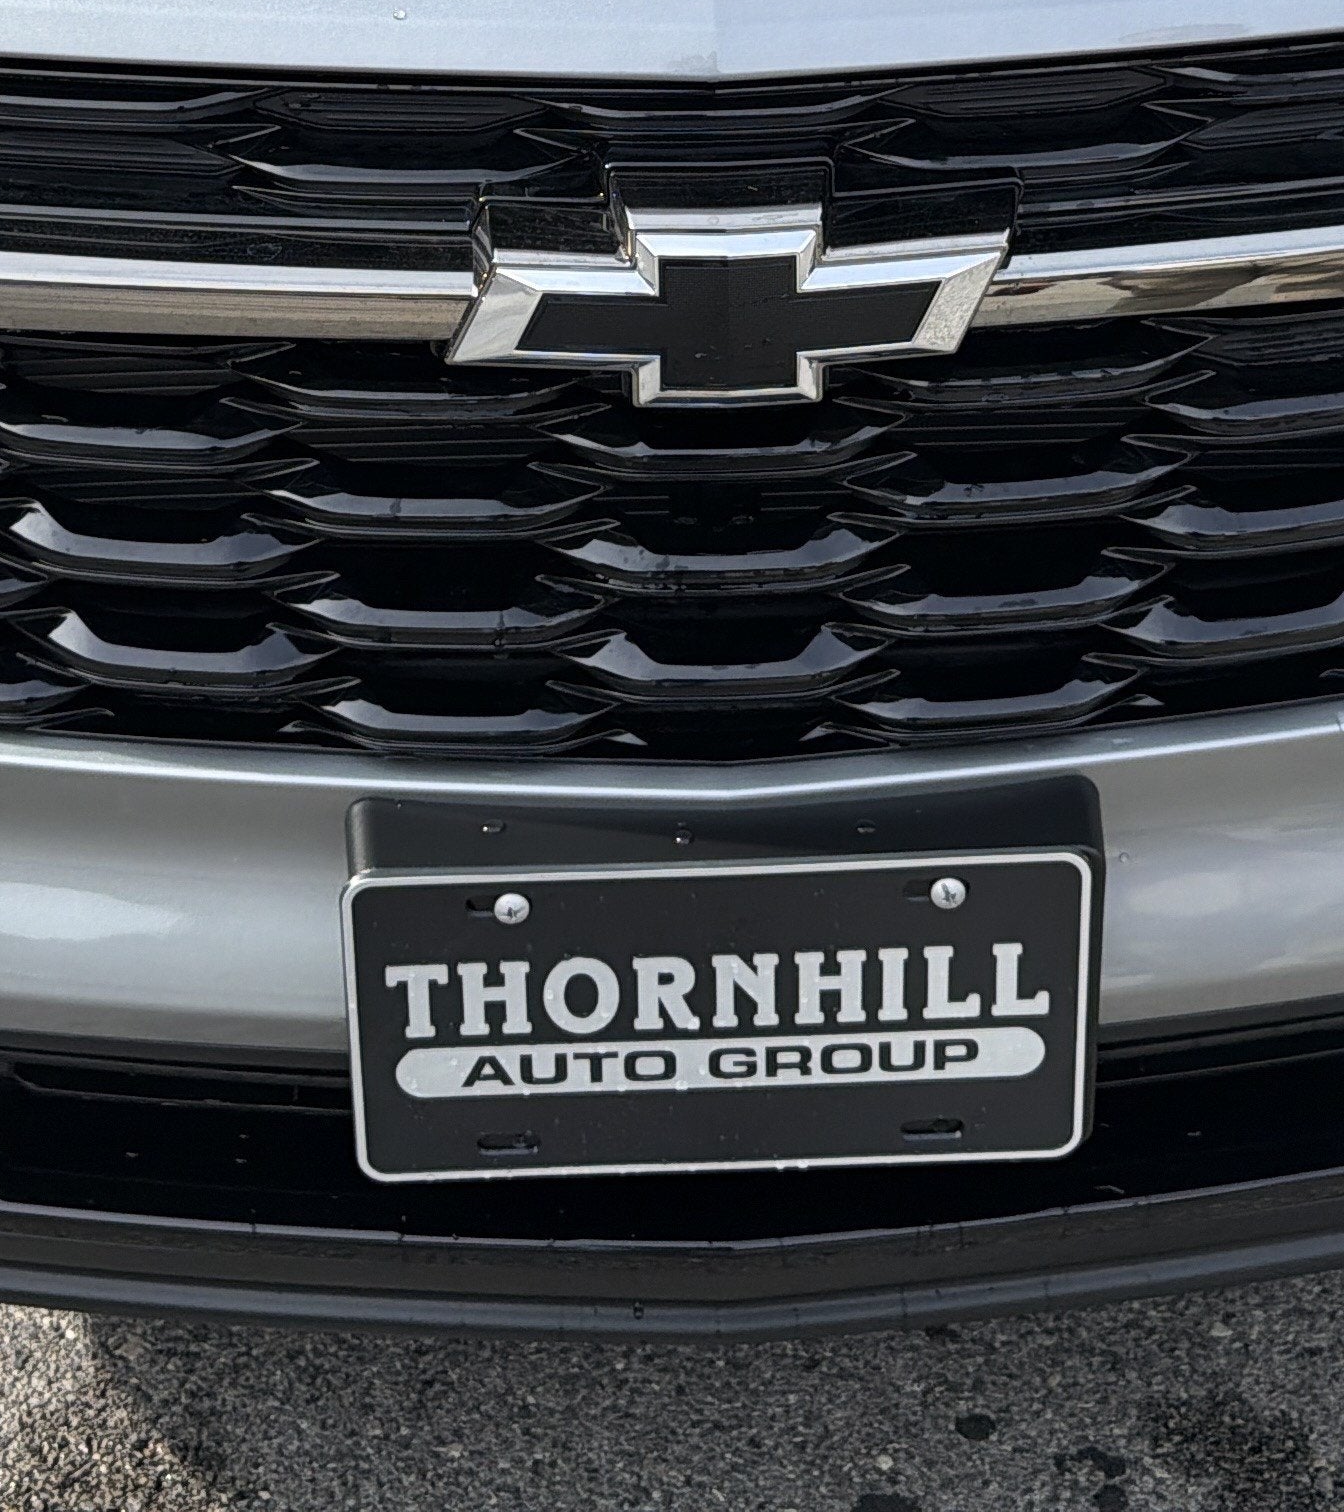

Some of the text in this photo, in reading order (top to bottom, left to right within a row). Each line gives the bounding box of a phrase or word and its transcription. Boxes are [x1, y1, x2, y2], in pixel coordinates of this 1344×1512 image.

[384, 942, 1049, 1038] THORNHILL
[460, 1038, 980, 1088] AUTO GROUP
